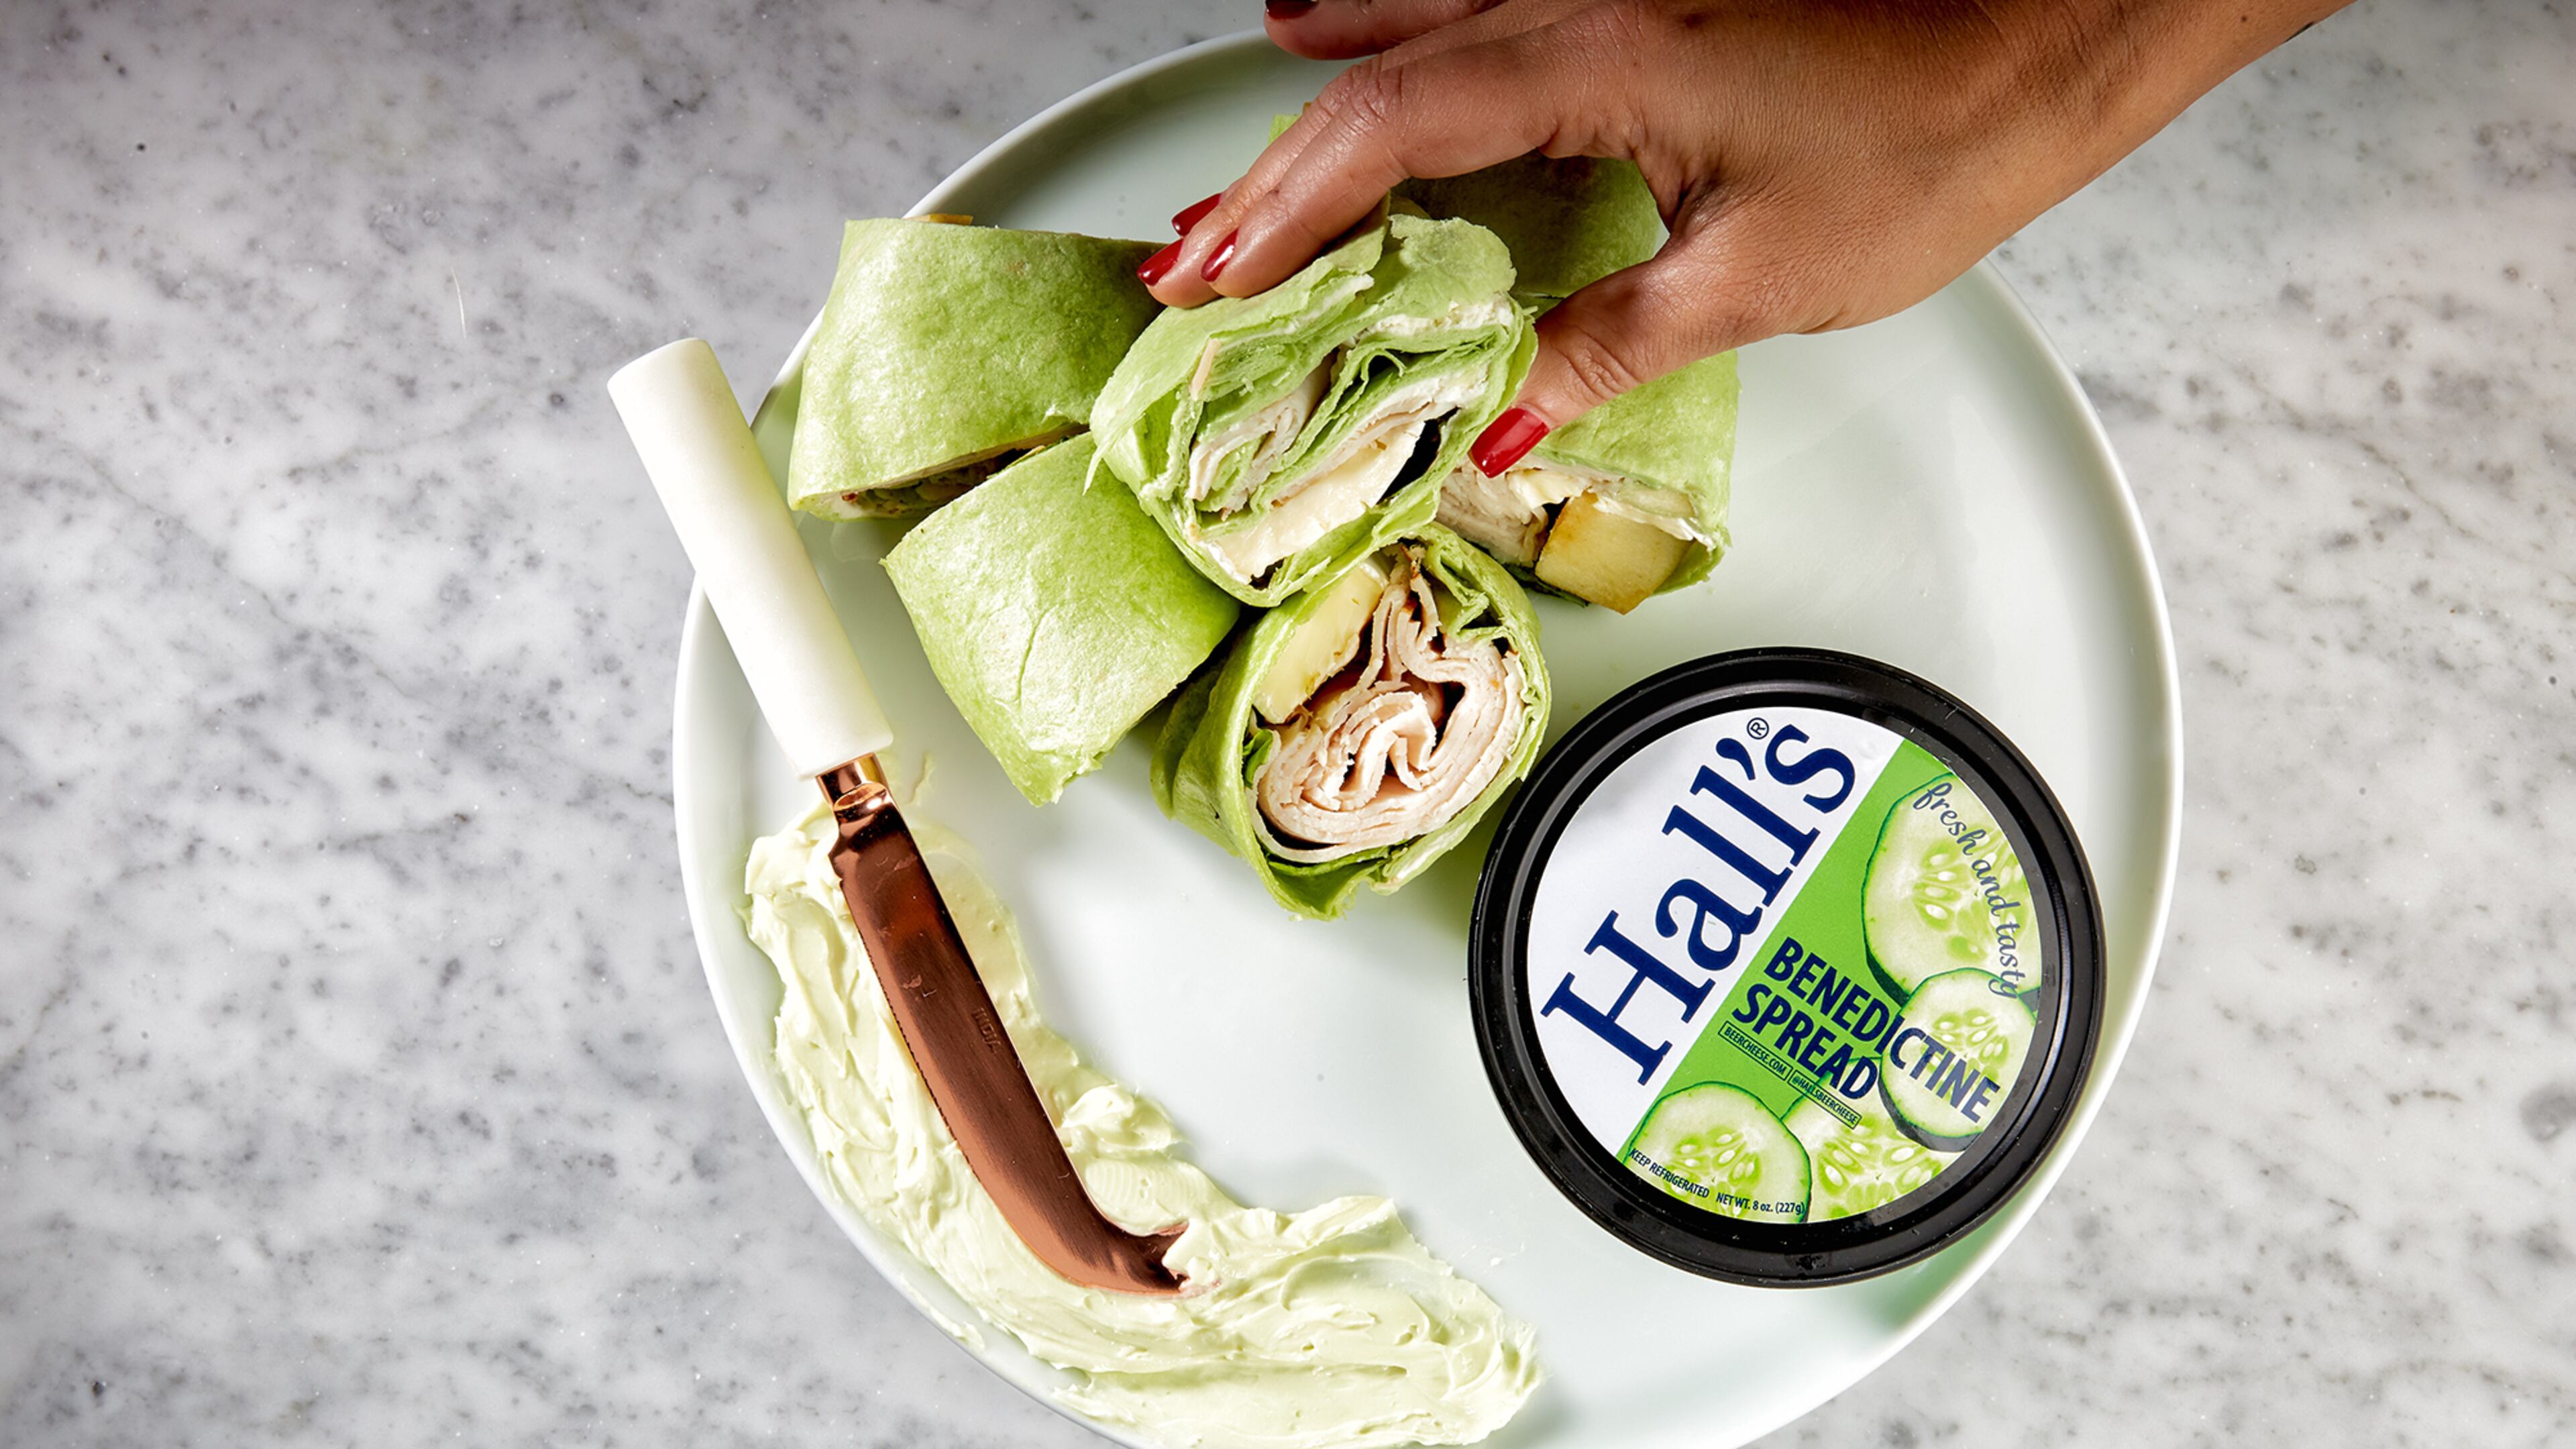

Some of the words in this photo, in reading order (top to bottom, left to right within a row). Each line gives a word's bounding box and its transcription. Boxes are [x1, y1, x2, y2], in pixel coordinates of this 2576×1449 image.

[1913, 782, 1986, 855] fresh
[1972, 859, 2021, 916] and
[1988, 921, 2026, 999] tasty
[1723, 1027, 1787, 1075] BEERCHEESE.COM
[1731, 983, 1878, 1099] SPREAD
[1764, 936, 2000, 1123] BENEDICTINE
[1791, 1075, 1858, 1125] @HALLSBEERCHEESE
[1629, 1147, 1651, 1167] KEEP
[1649, 1162, 1710, 1199] REFRIGERATED
[1715, 1192, 1734, 1207] NET
[1733, 1197, 1751, 1210] WT.
[1752, 1200, 1760, 1212] 8
[1760, 1203, 1774, 1212] oz.
[1775, 1201, 1806, 1215] (227g)
